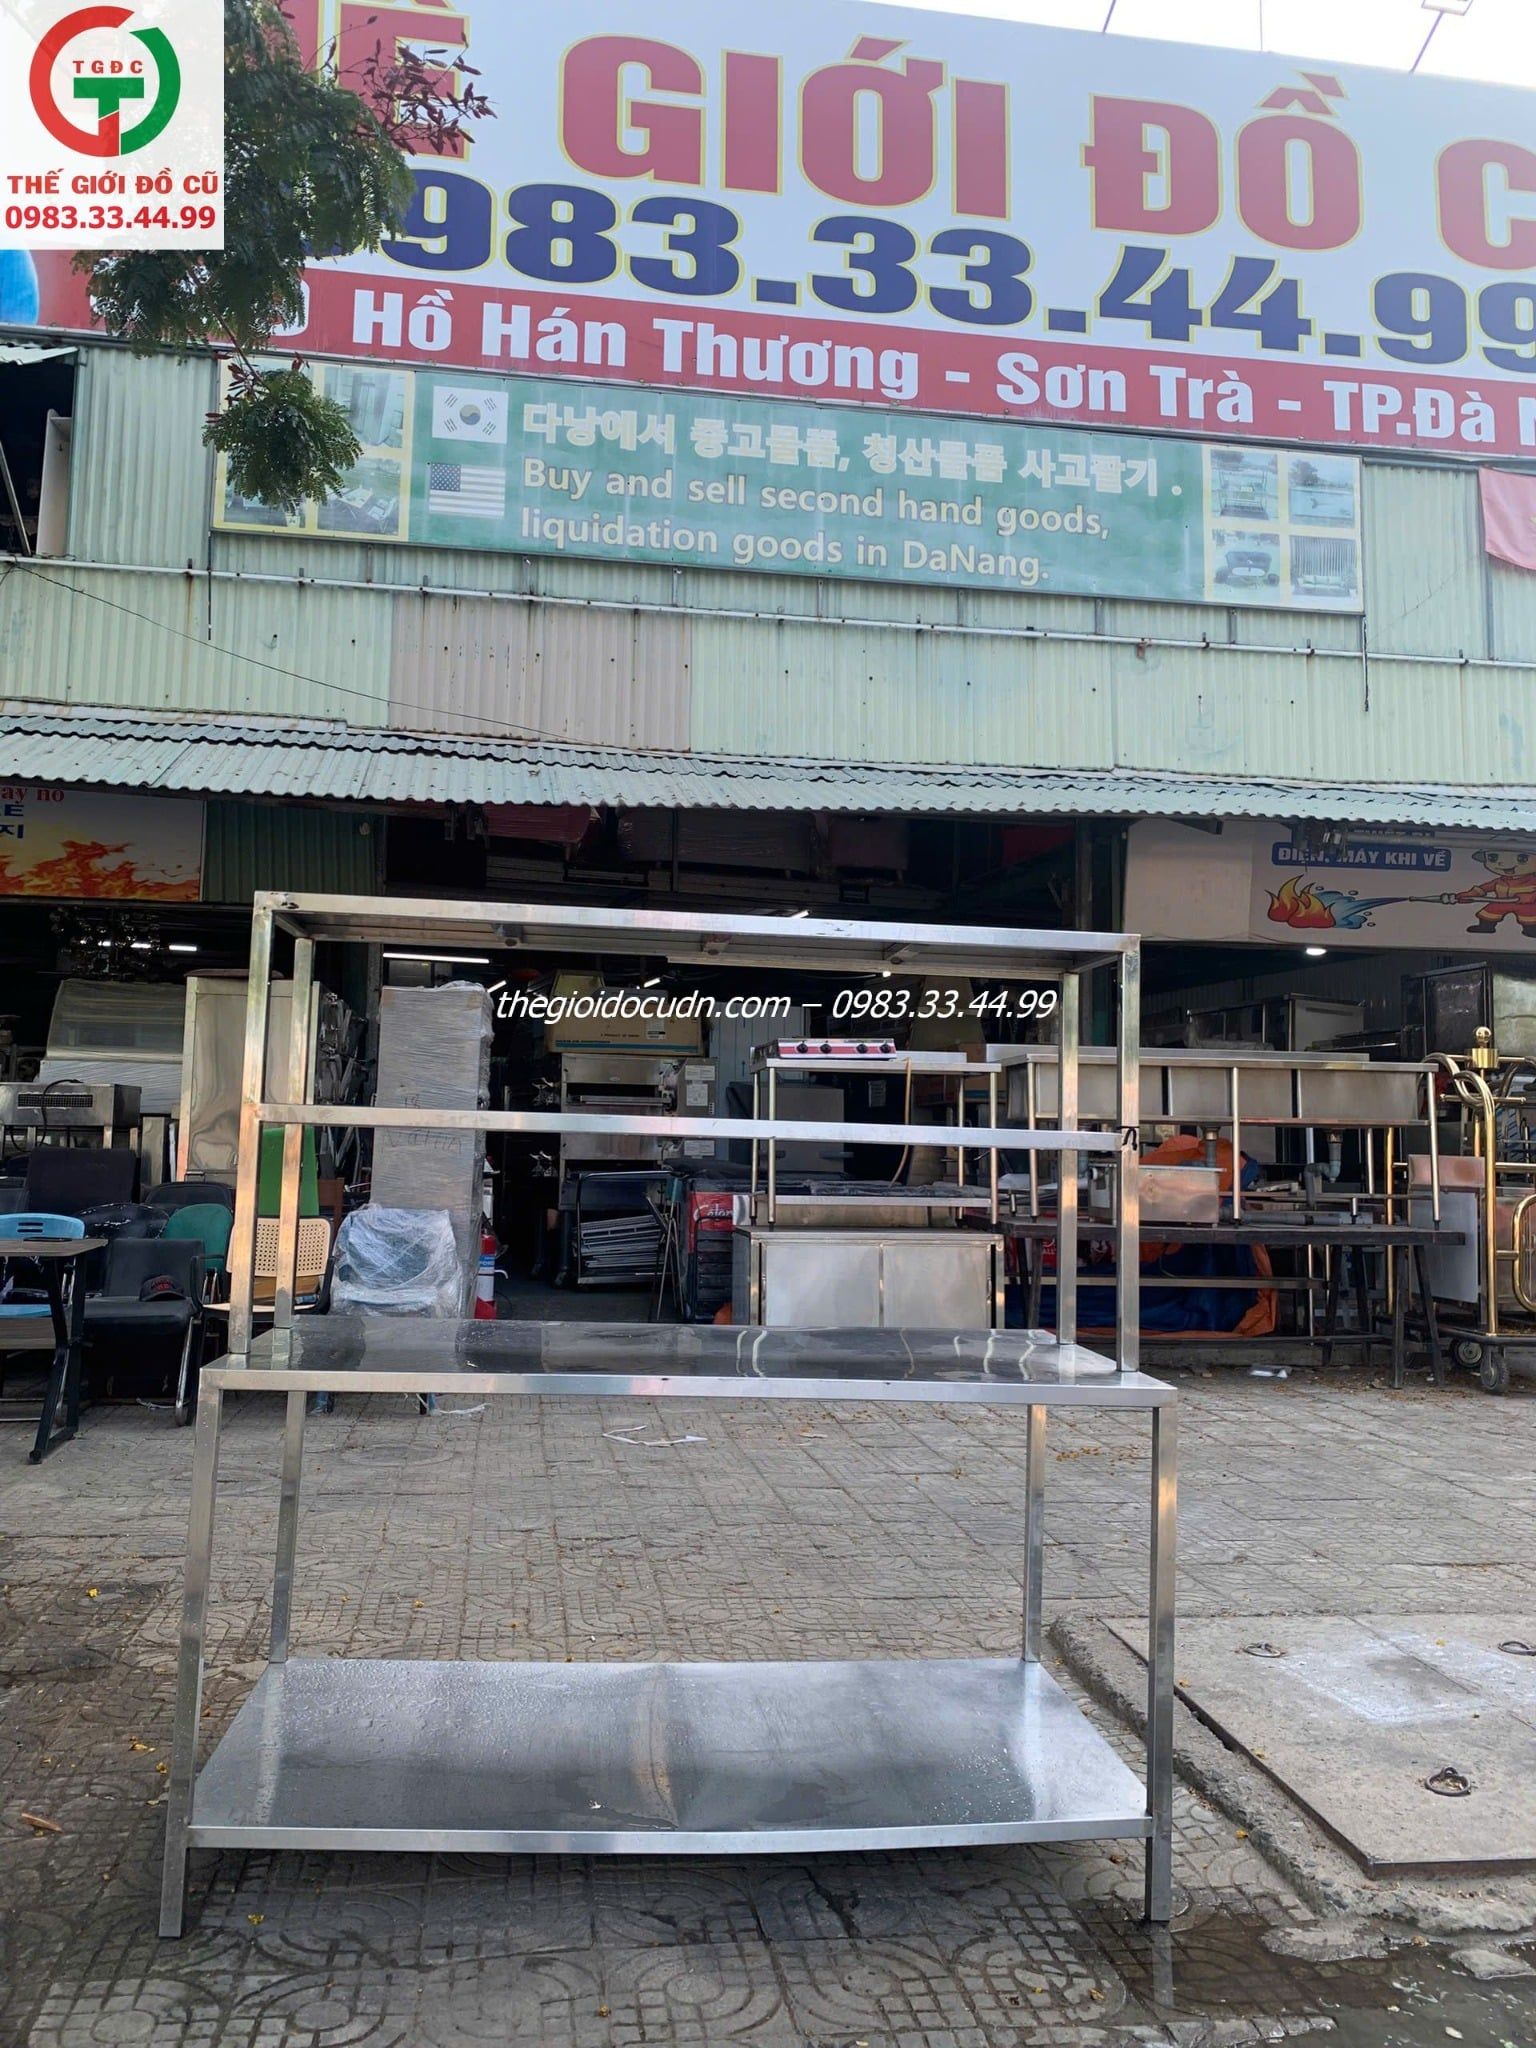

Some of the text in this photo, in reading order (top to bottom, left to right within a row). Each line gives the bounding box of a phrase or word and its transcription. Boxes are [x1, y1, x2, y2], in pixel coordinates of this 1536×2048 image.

[559, 35, 1010, 221] GIỚI
[1083, 71, 1362, 251] ĐỒ
[303, 167, 1536, 375] 983.33.44.99
[352, 288, 454, 352] Hồ
[481, 302, 626, 368] Hán
[652, 318, 918, 400] Thương
[996, 353, 1127, 412] Sơn
[1149, 365, 1254, 424] Trà
[1324, 380, 1496, 443] TP.Đà
[523, 402, 676, 455] 다낭에서
[524, 458, 1109, 540] Buy and sell second hand goods,
[521, 507, 1049, 586] liquidation goods in DaNang.
[1385, 851, 1417, 866] KHI
